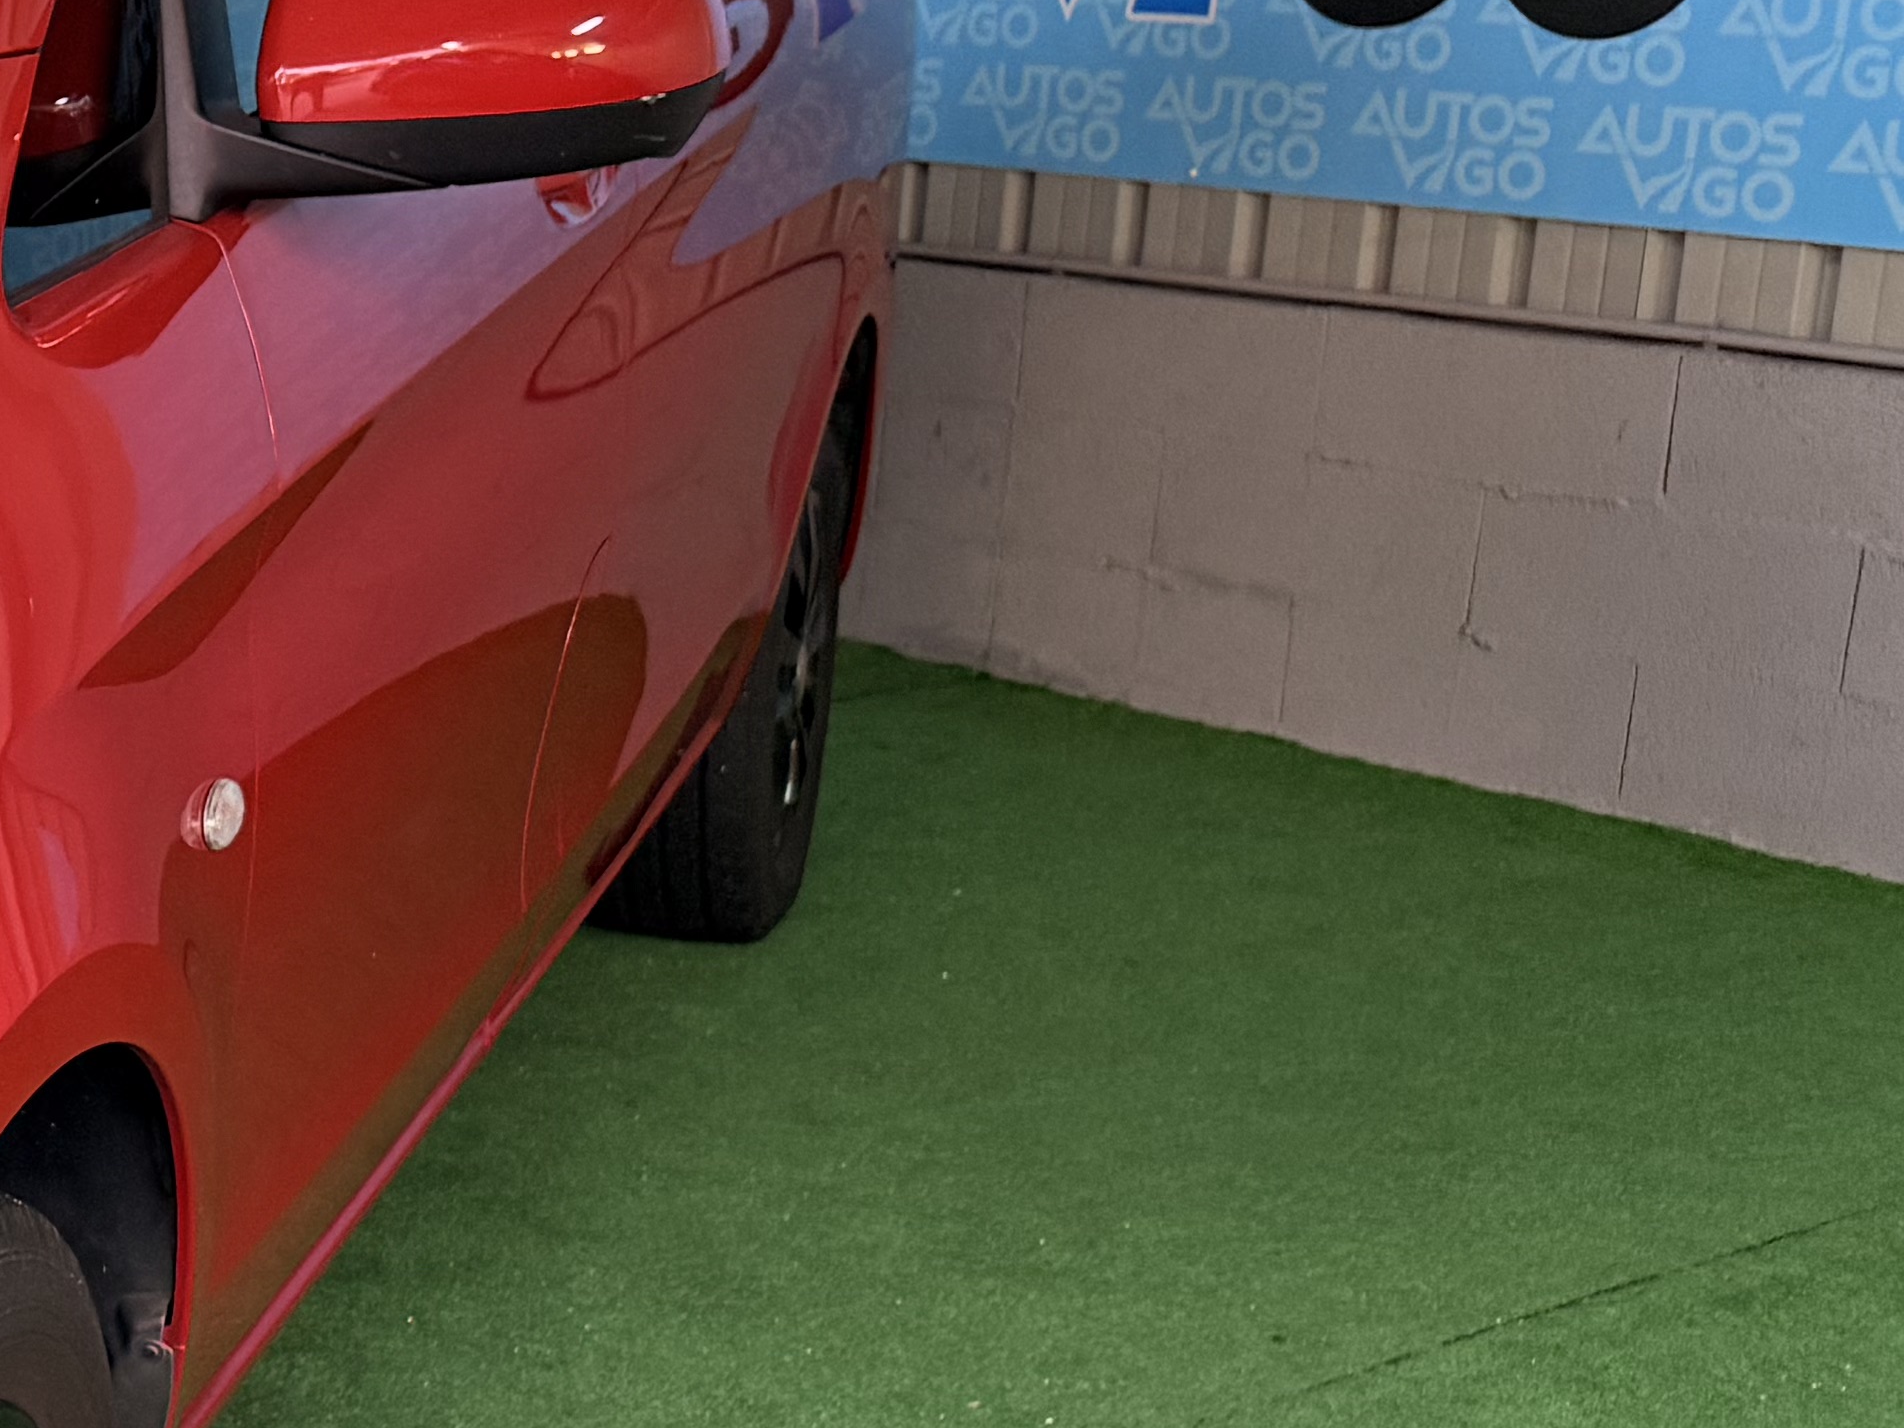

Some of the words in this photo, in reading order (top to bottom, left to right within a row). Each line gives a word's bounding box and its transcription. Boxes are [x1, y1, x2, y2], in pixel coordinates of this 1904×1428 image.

[960, 61, 1127, 115] AUTOS
[1146, 75, 1328, 130] AUTOS
[1350, 85, 1554, 149] AUTOS
[994, 109, 1120, 162] VIGO
[1178, 123, 1320, 180] VIGO
[1576, 102, 1804, 169] AUTOS
[1390, 139, 1545, 201] VIGO
[1614, 155, 1796, 223] VIGO
